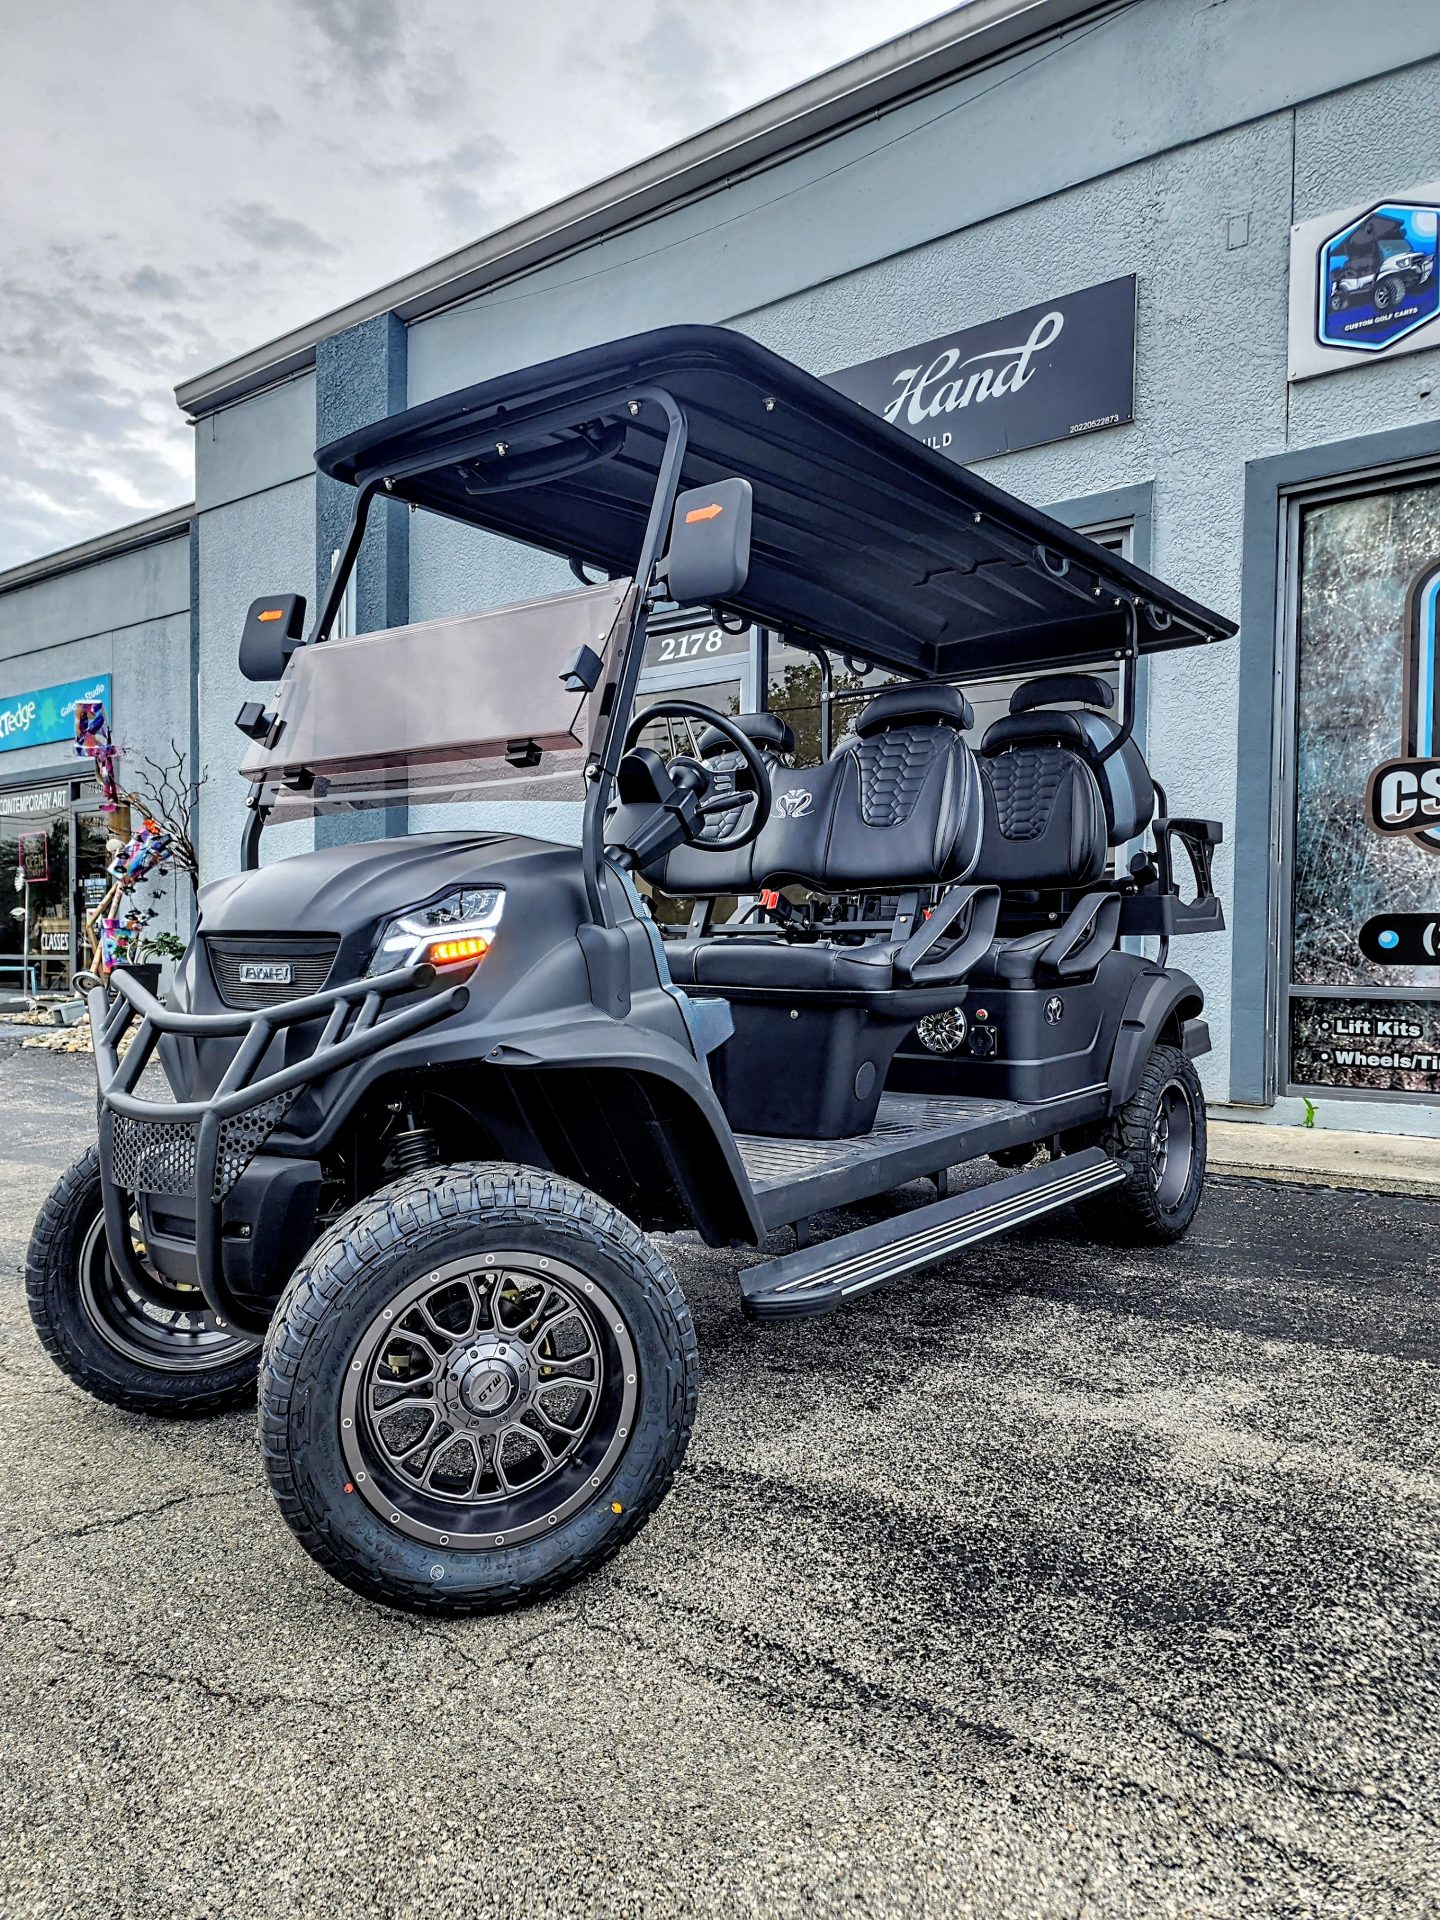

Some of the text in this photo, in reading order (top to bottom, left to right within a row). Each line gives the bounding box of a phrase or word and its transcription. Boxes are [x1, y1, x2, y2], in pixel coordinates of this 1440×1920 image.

[1344, 307, 1418, 332] CUSTOM GOLF CARTS
[883, 311, 1065, 425] Hand
[658, 629, 723, 662] 2178
[84, 684, 105, 700] Studio
[52, 790, 67, 809] ART
[40, 933, 69, 951] CLASSES
[1336, 1020, 1421, 1036] Lift Kits
[1335, 1050, 1440, 1070] Wheels/Ti
[478, 1374, 502, 1403] GTW
